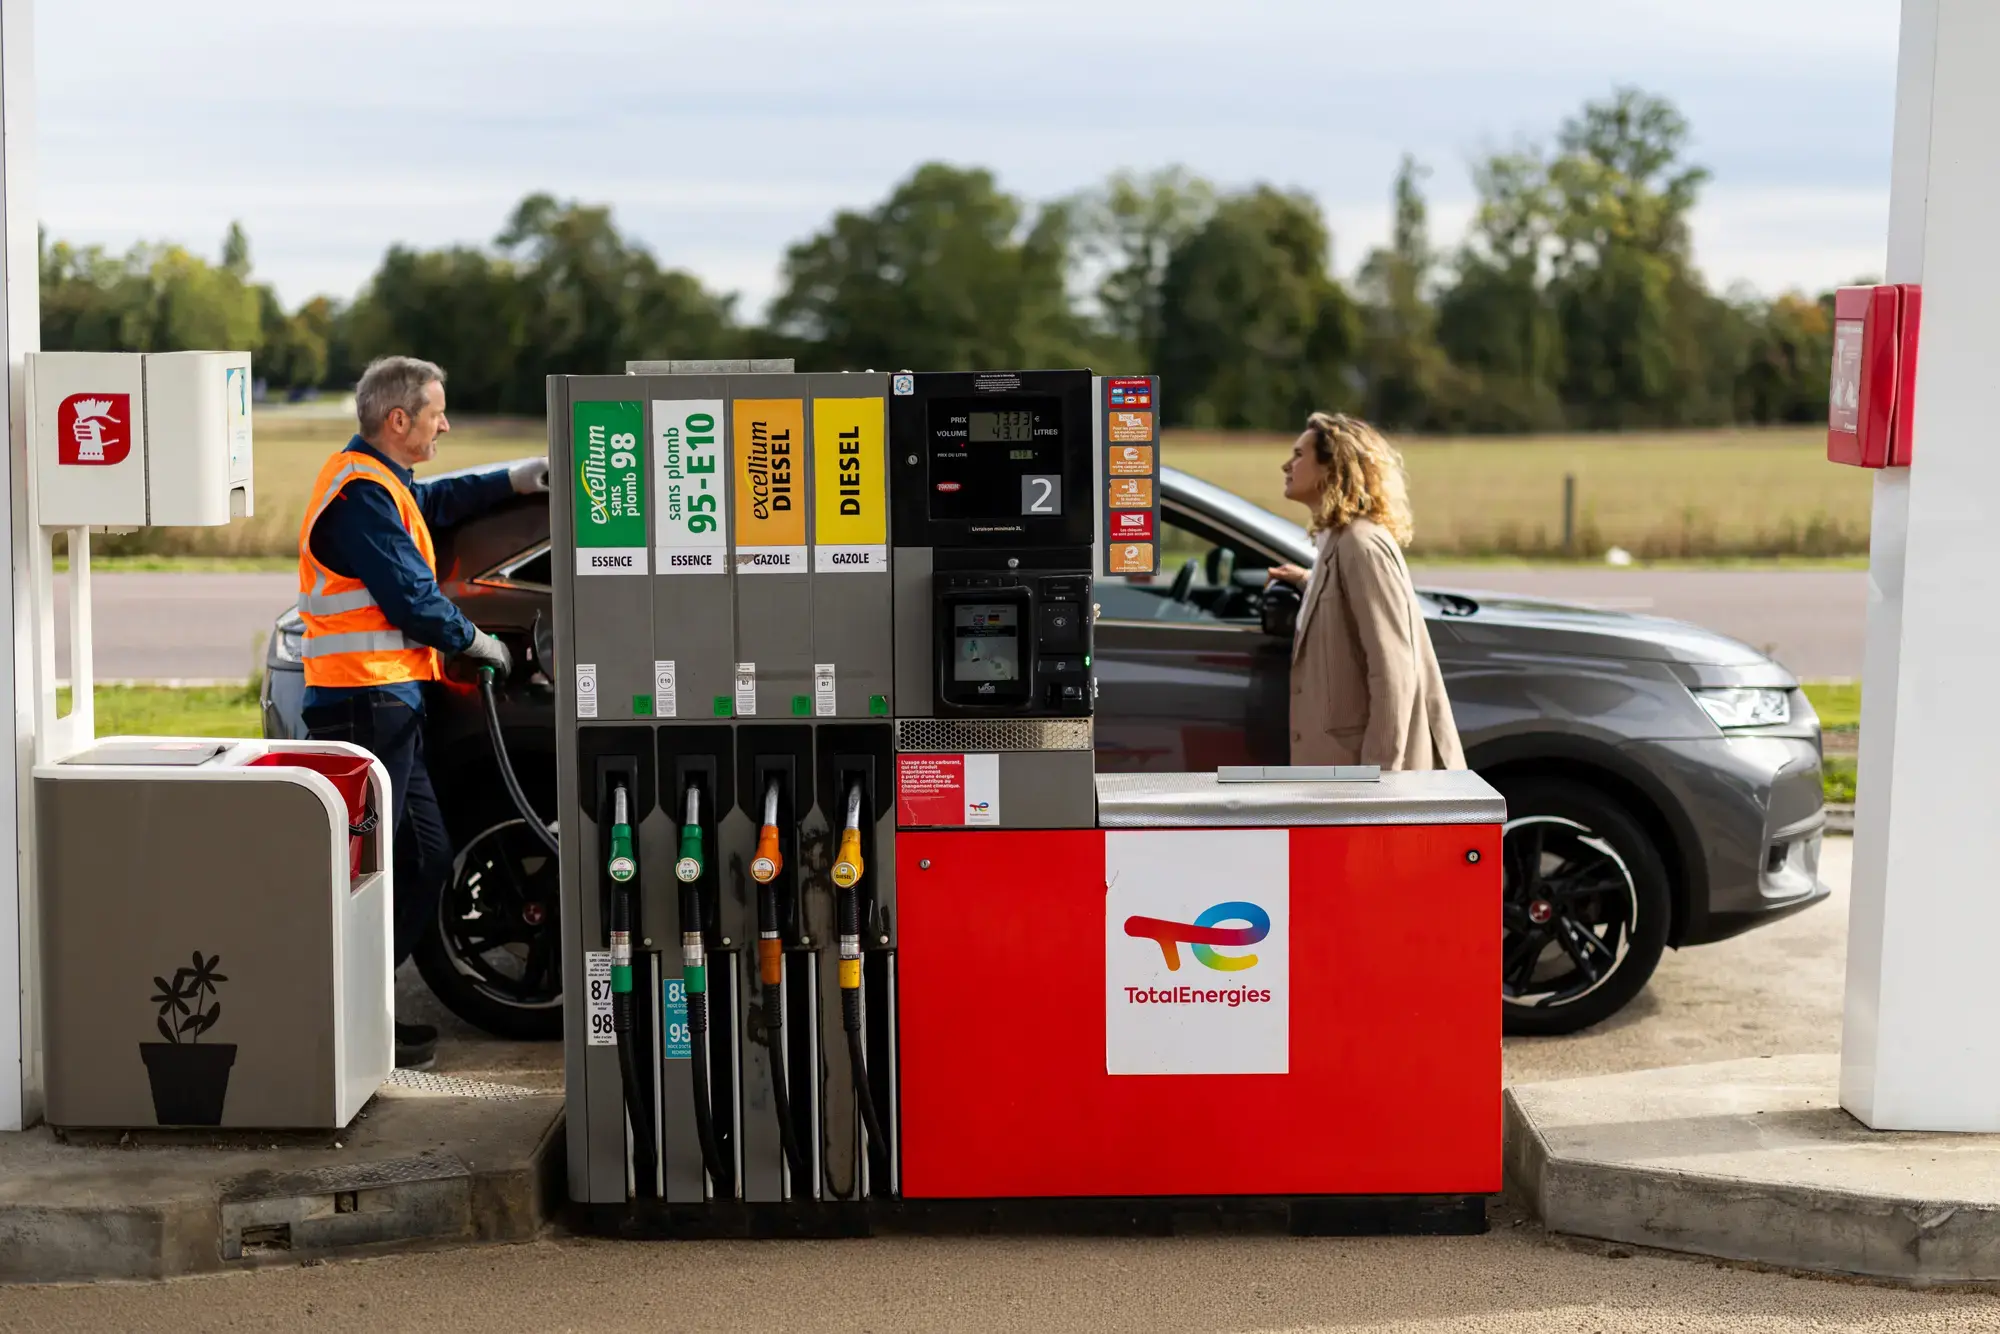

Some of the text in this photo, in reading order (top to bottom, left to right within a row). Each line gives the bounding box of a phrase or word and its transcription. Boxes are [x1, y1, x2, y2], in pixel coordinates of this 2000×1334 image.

[610, 432, 636, 468] 98
[664, 427, 684, 480] plomb
[584, 425, 608, 525] excellium
[686, 413, 718, 534] 95-E10
[748, 421, 768, 520] excellium
[772, 429, 790, 512] DIESEL
[838, 426, 860, 516] DIESEL
[610, 485, 622, 516] sans
[626, 472, 640, 516] plomb
[669, 484, 680, 521] sans
[1030, 478, 1053, 512] 2
[592, 556, 632, 567] ESSENCE
[671, 555, 712, 566] ESSENCE
[753, 554, 790, 566] GAZOLE
[832, 554, 870, 564] GAZOLE
[591, 980, 611, 1000] 87
[1124, 985, 1270, 1007] TotalEnergies
[592, 1014, 612, 1033] 98
[670, 1023, 691, 1042] 95
